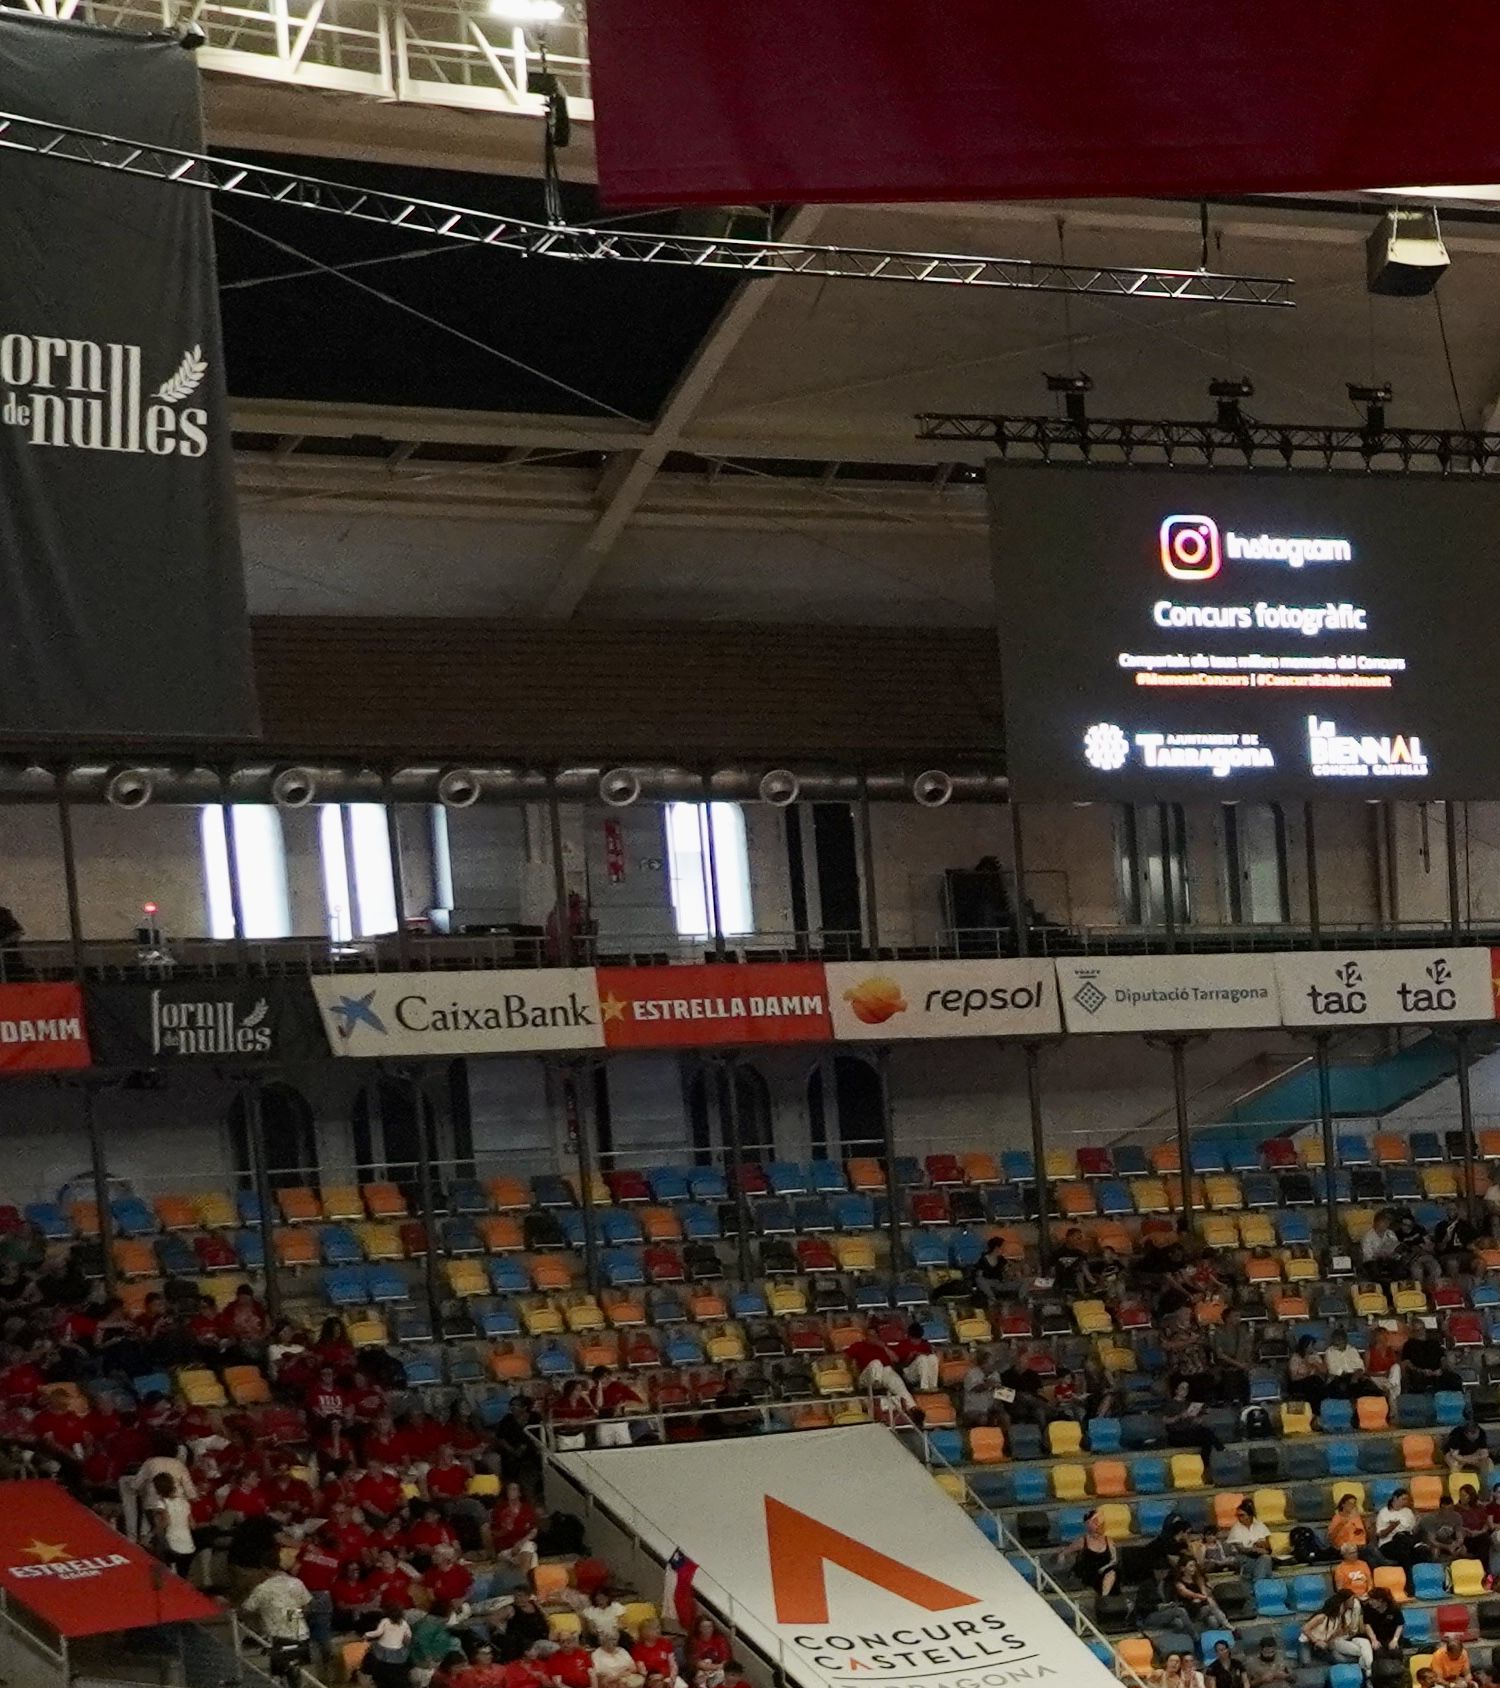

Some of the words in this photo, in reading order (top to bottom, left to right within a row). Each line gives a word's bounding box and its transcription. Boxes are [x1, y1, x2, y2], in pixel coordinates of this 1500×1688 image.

[0, 332, 106, 393] orn
[3, 397, 31, 428] de
[29, 345, 208, 458] nulles
[1226, 532, 1352, 568] Instagram
[1153, 600, 1252, 628] Concurs
[1255, 602, 1368, 635] fotogràfic
[1310, 734, 1429, 765] BIENNAL
[633, 997, 749, 1021] ESTRELLA
[751, 994, 824, 1017] DAMM
[925, 980, 1043, 1018] repsol
[1115, 985, 1190, 1007] Diputació
[1192, 983, 1269, 1006] Tarragona
[1307, 984, 1367, 1015] tac
[1396, 982, 1457, 1012] tac
[1, 1017, 82, 1044] DAMM
[395, 993, 597, 1034] CaixaBank
[8, 1553, 131, 1579] ESTRELLA
[794, 1613, 1008, 1652] CONCURS
[813, 1633, 1028, 1672] CASTELLS
